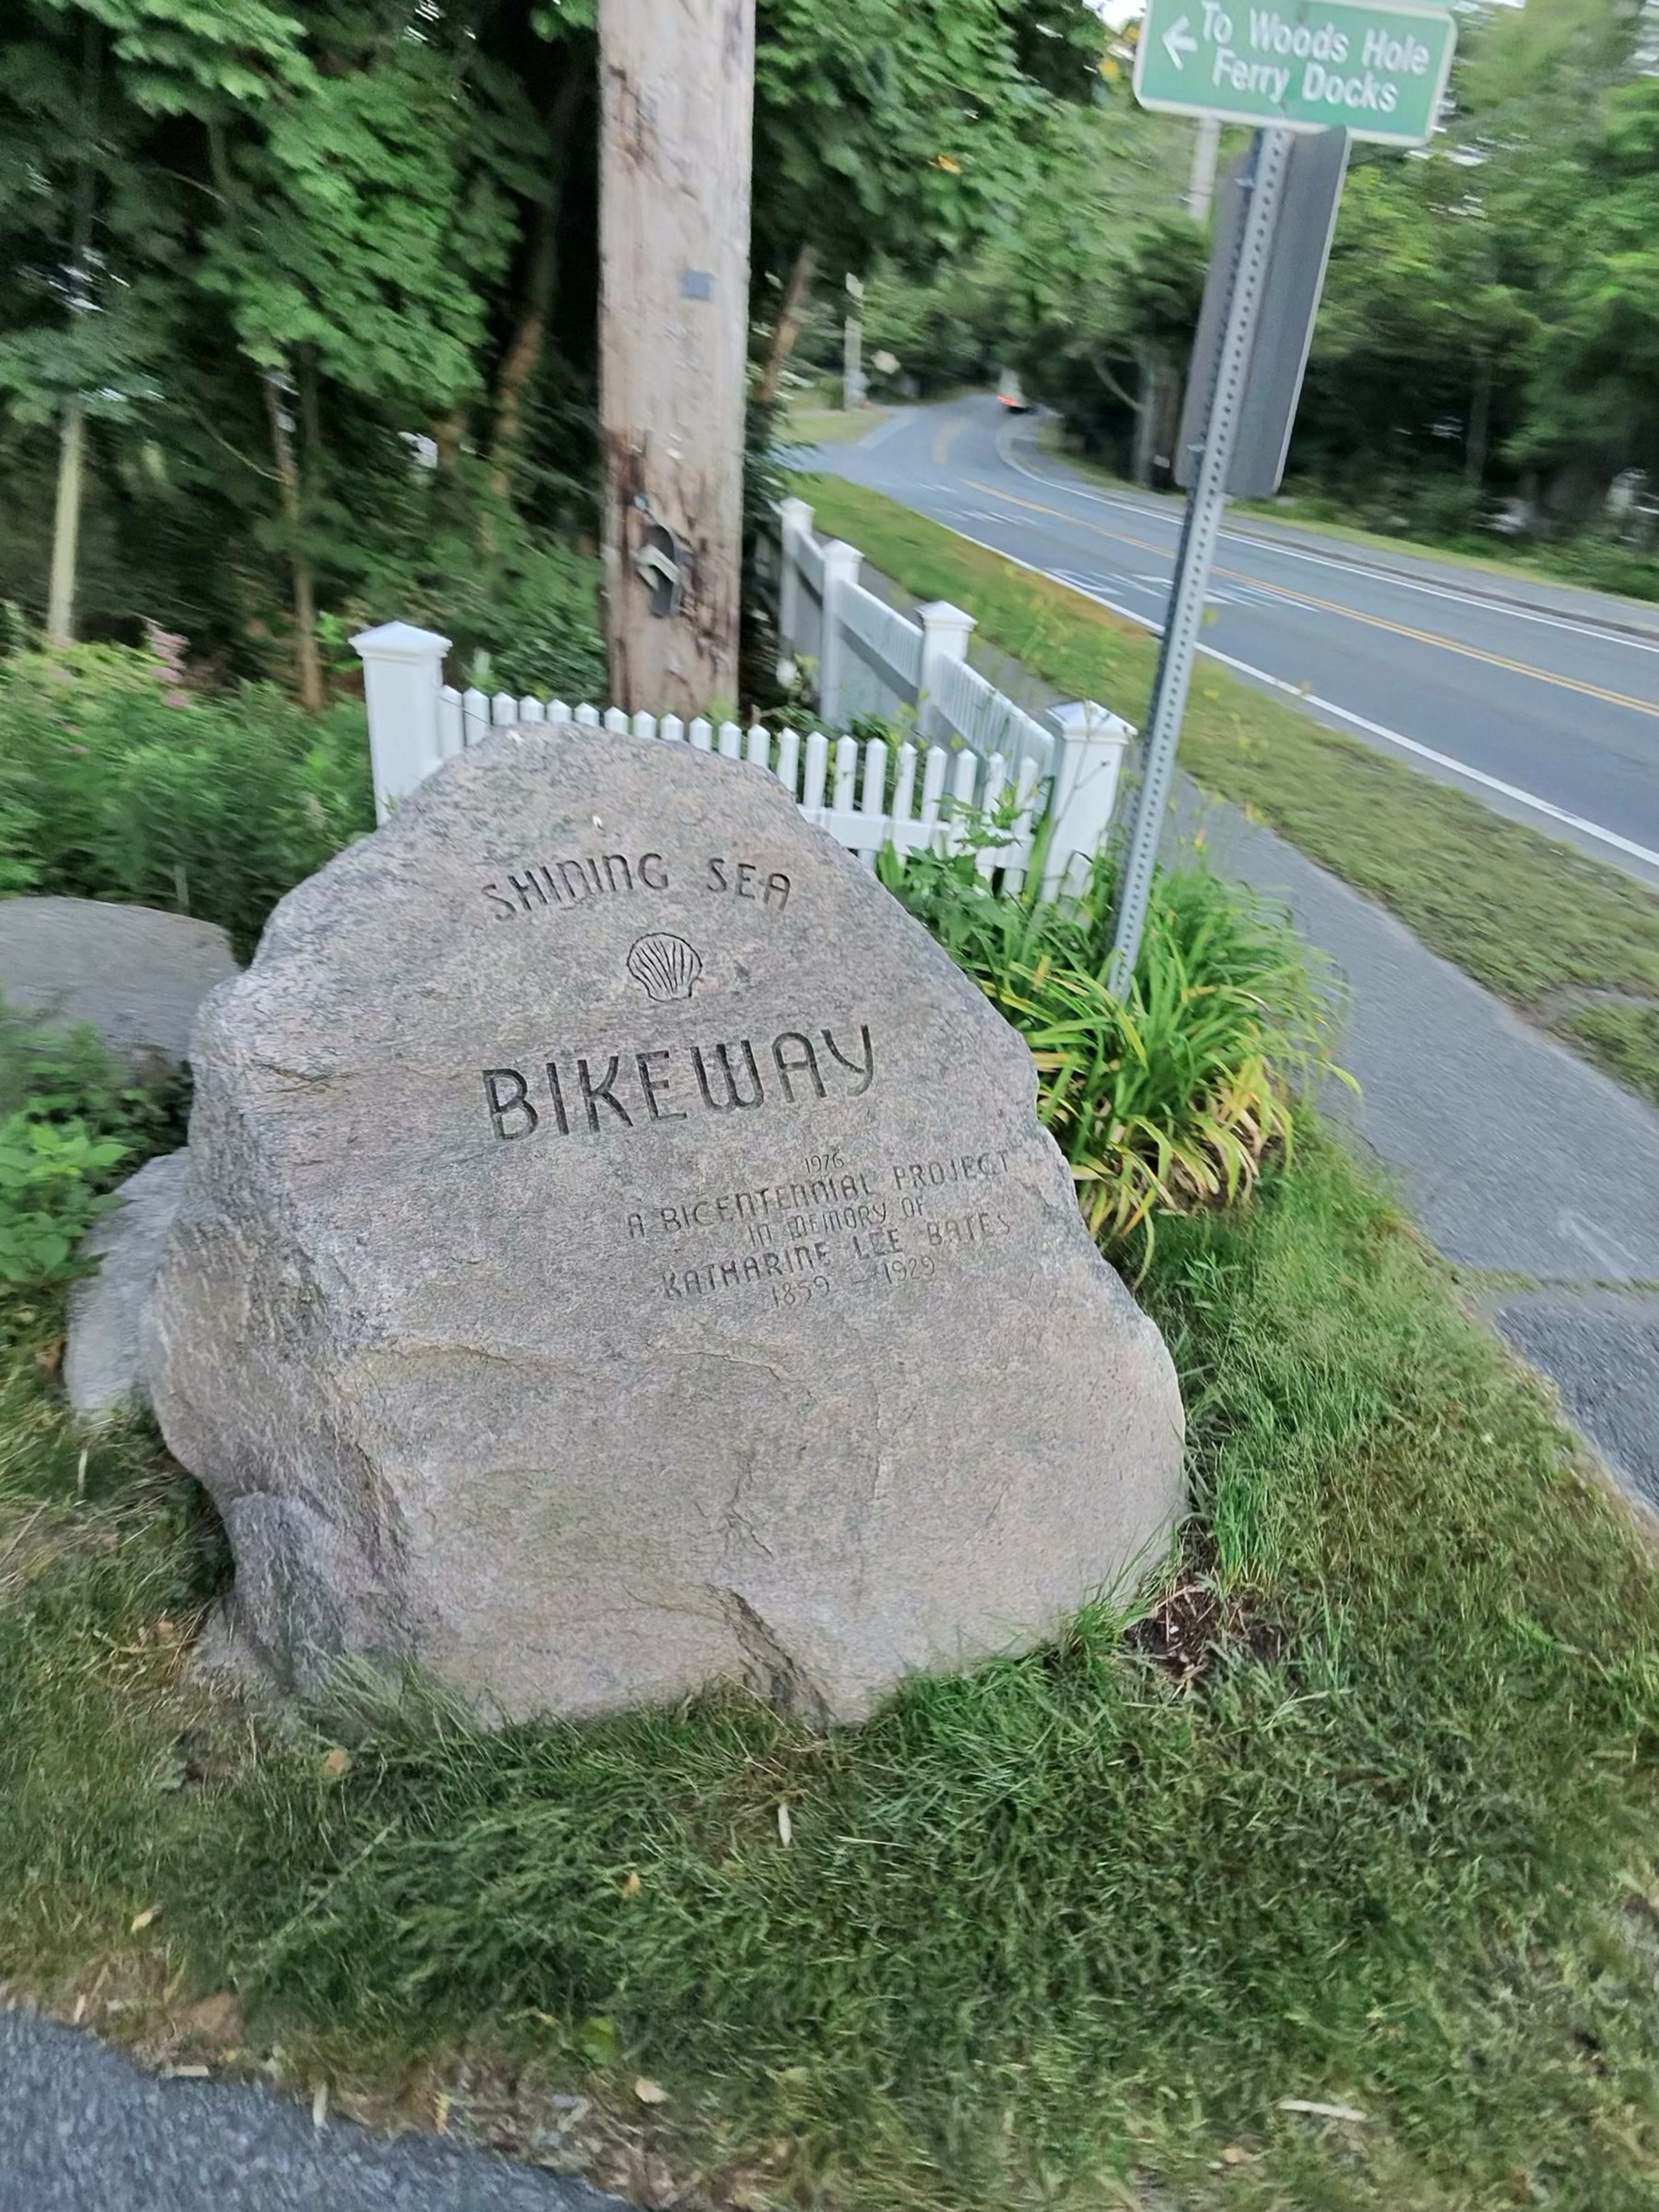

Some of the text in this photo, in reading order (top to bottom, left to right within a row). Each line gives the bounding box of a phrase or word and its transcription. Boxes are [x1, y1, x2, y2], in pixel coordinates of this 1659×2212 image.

[1202, 0, 1430, 76] To Woods Hole
[1212, 47, 1399, 113] Ferry Docks
[481, 852, 791, 921] SHINING SEA
[482, 1024, 874, 1141] BIKEWAY
[627, 1149, 1008, 1239] A BICENTENNIAL PROJECT
[804, 1152, 845, 1173] 1976
[662, 1212, 1010, 1298] KATHARINE LEE BATES
[747, 1196, 925, 1247] IN MEMORY OF
[772, 1274, 830, 1307] 1859
[883, 1255, 935, 1285] 1929
